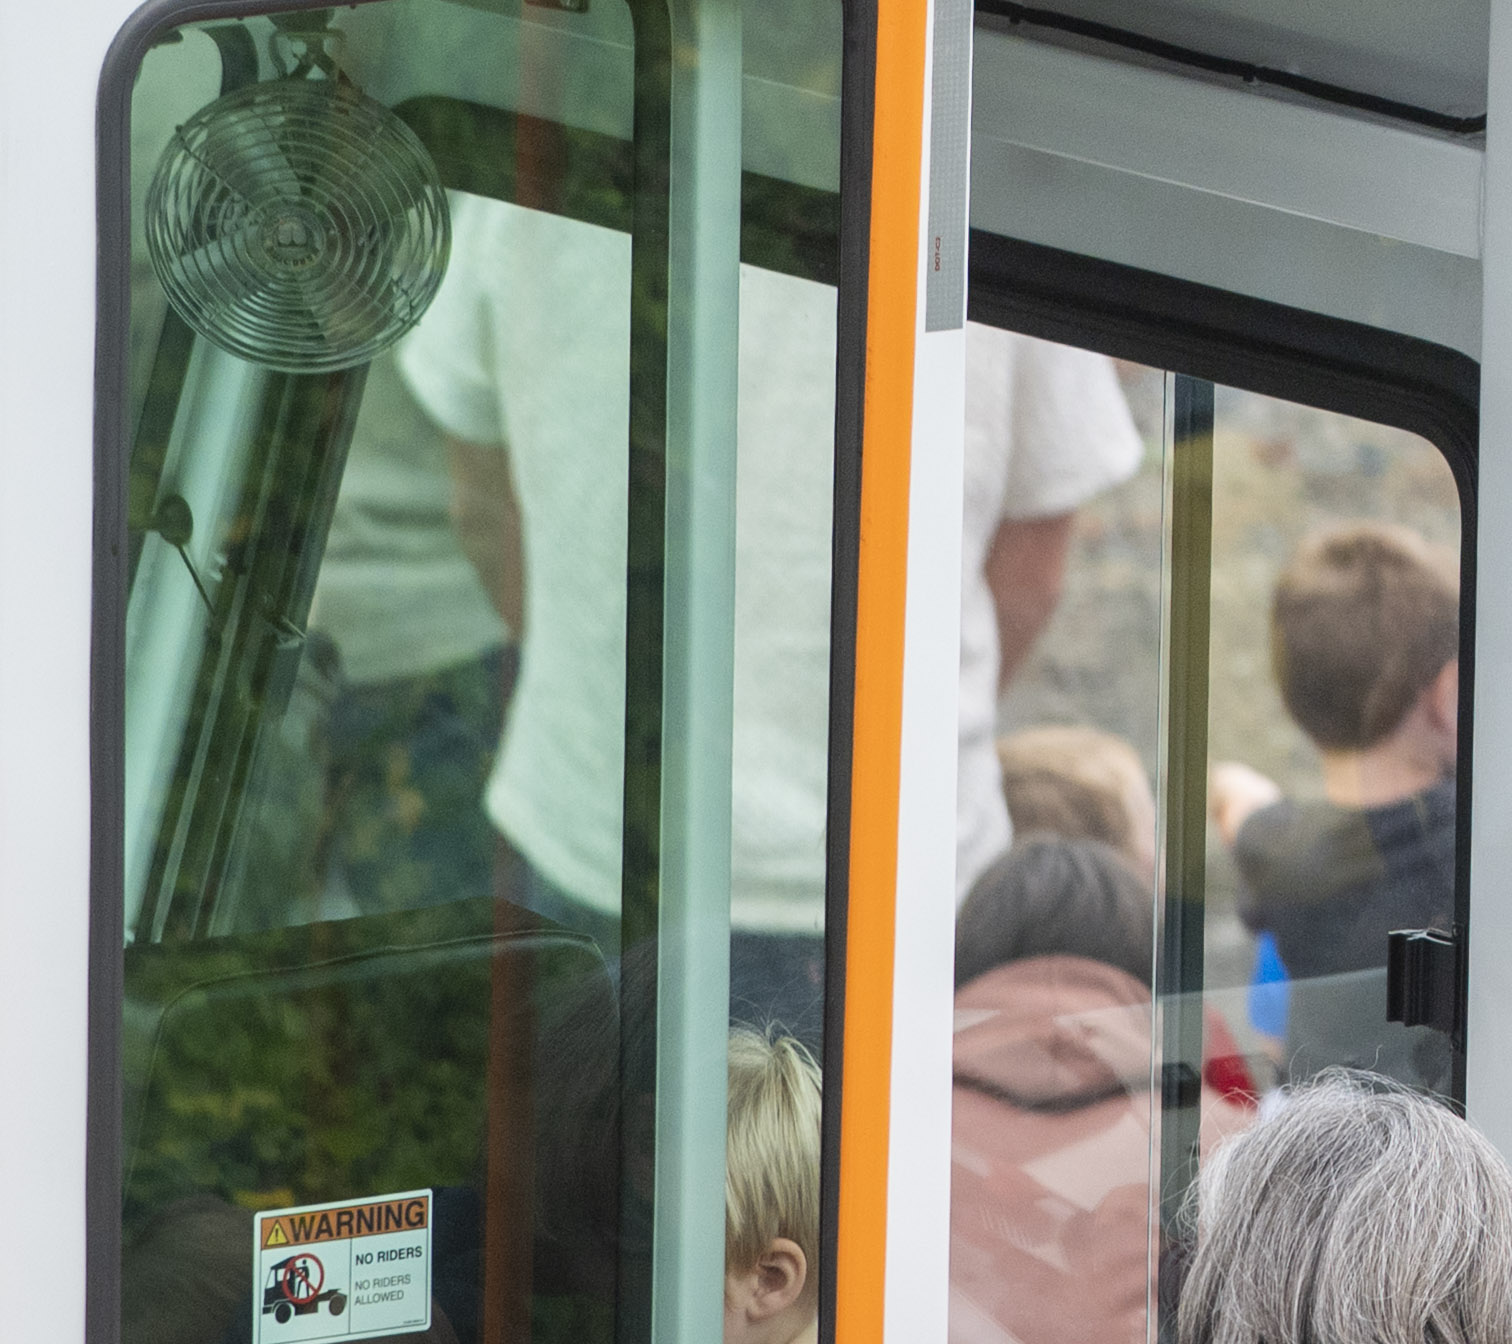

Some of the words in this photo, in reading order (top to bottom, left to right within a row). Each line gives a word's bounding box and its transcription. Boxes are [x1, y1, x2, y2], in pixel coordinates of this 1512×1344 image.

[289, 1201, 425, 1242] WARNING
[355, 1251, 374, 1266] NO
[377, 1245, 423, 1263] RIDERS
[354, 1279, 371, 1291] NO
[372, 1274, 411, 1289] RIDERS
[354, 1290, 404, 1307] ALLOWED
